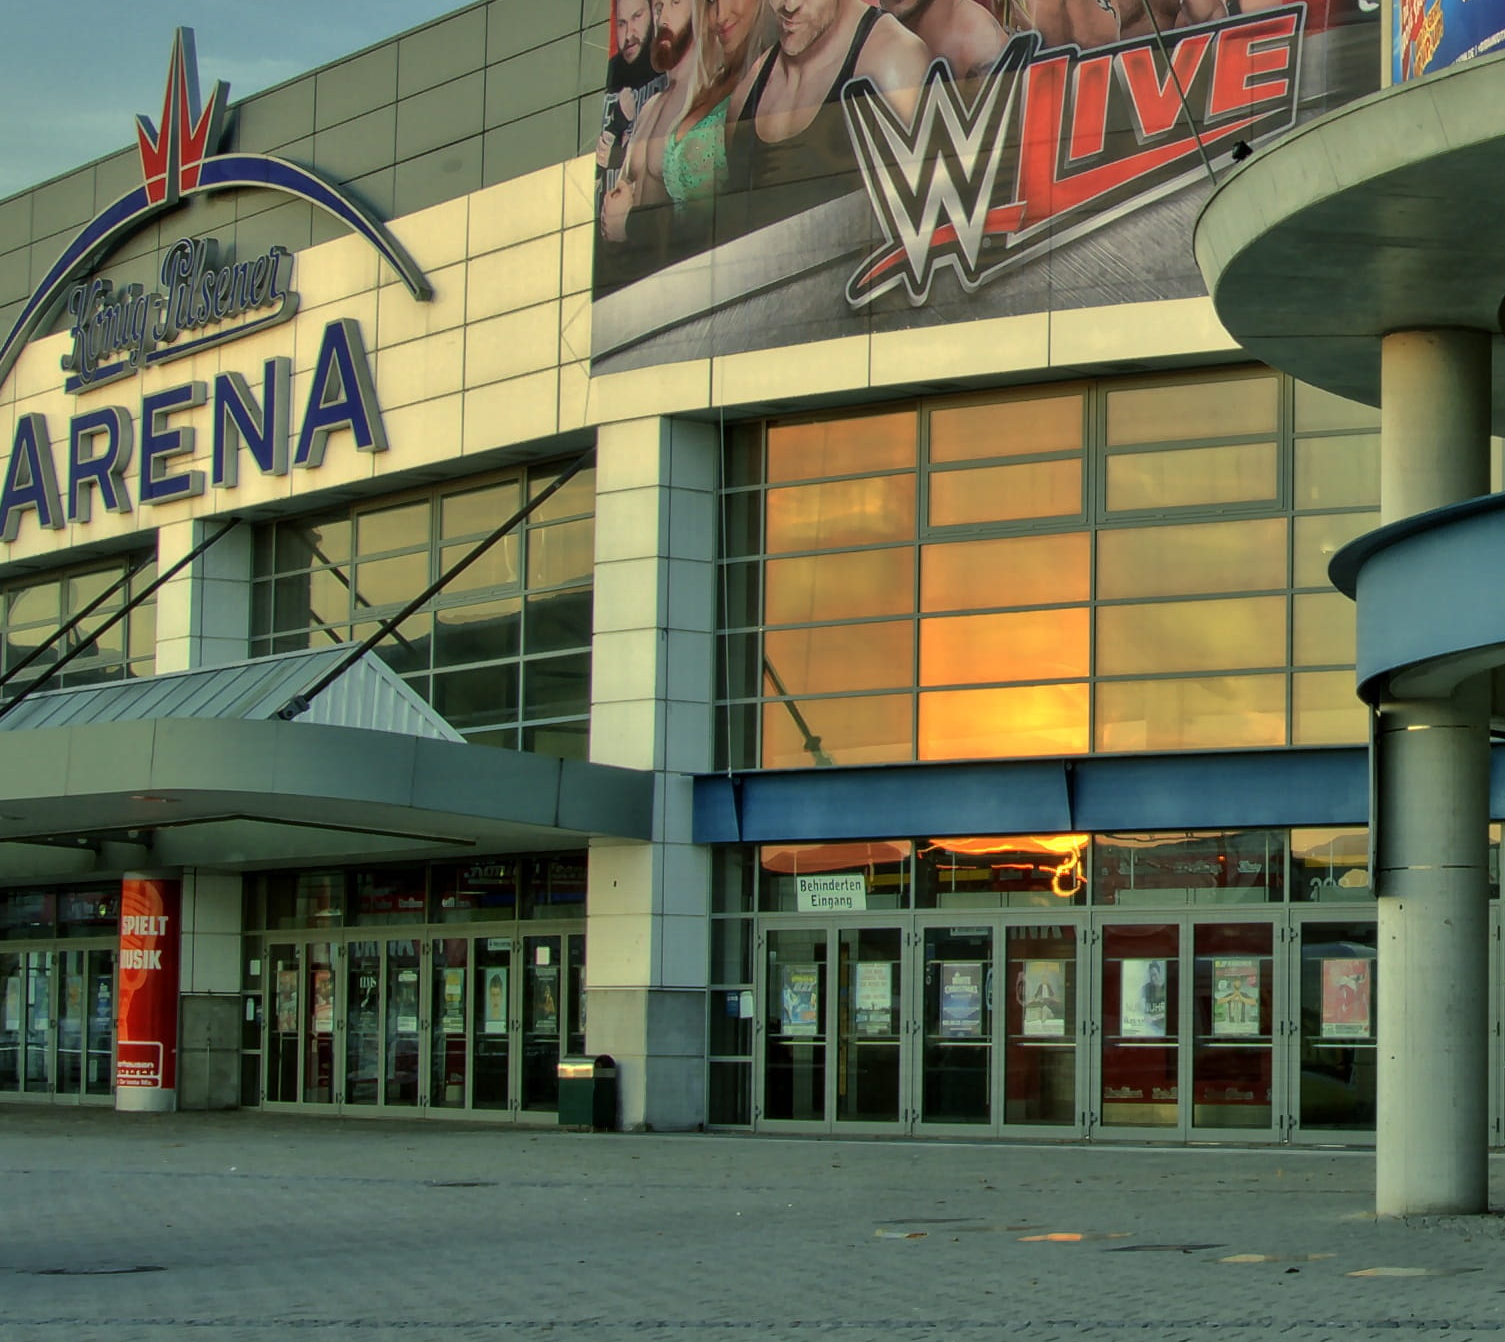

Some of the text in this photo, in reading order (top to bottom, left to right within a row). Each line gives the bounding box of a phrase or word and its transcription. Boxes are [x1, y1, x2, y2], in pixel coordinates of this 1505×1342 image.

[1010, 16, 1296, 245] LIVE
[62, 237, 293, 383] König-Pilsener
[800, 879, 861, 893] Behinderten
[811, 895, 853, 909] Eingang
